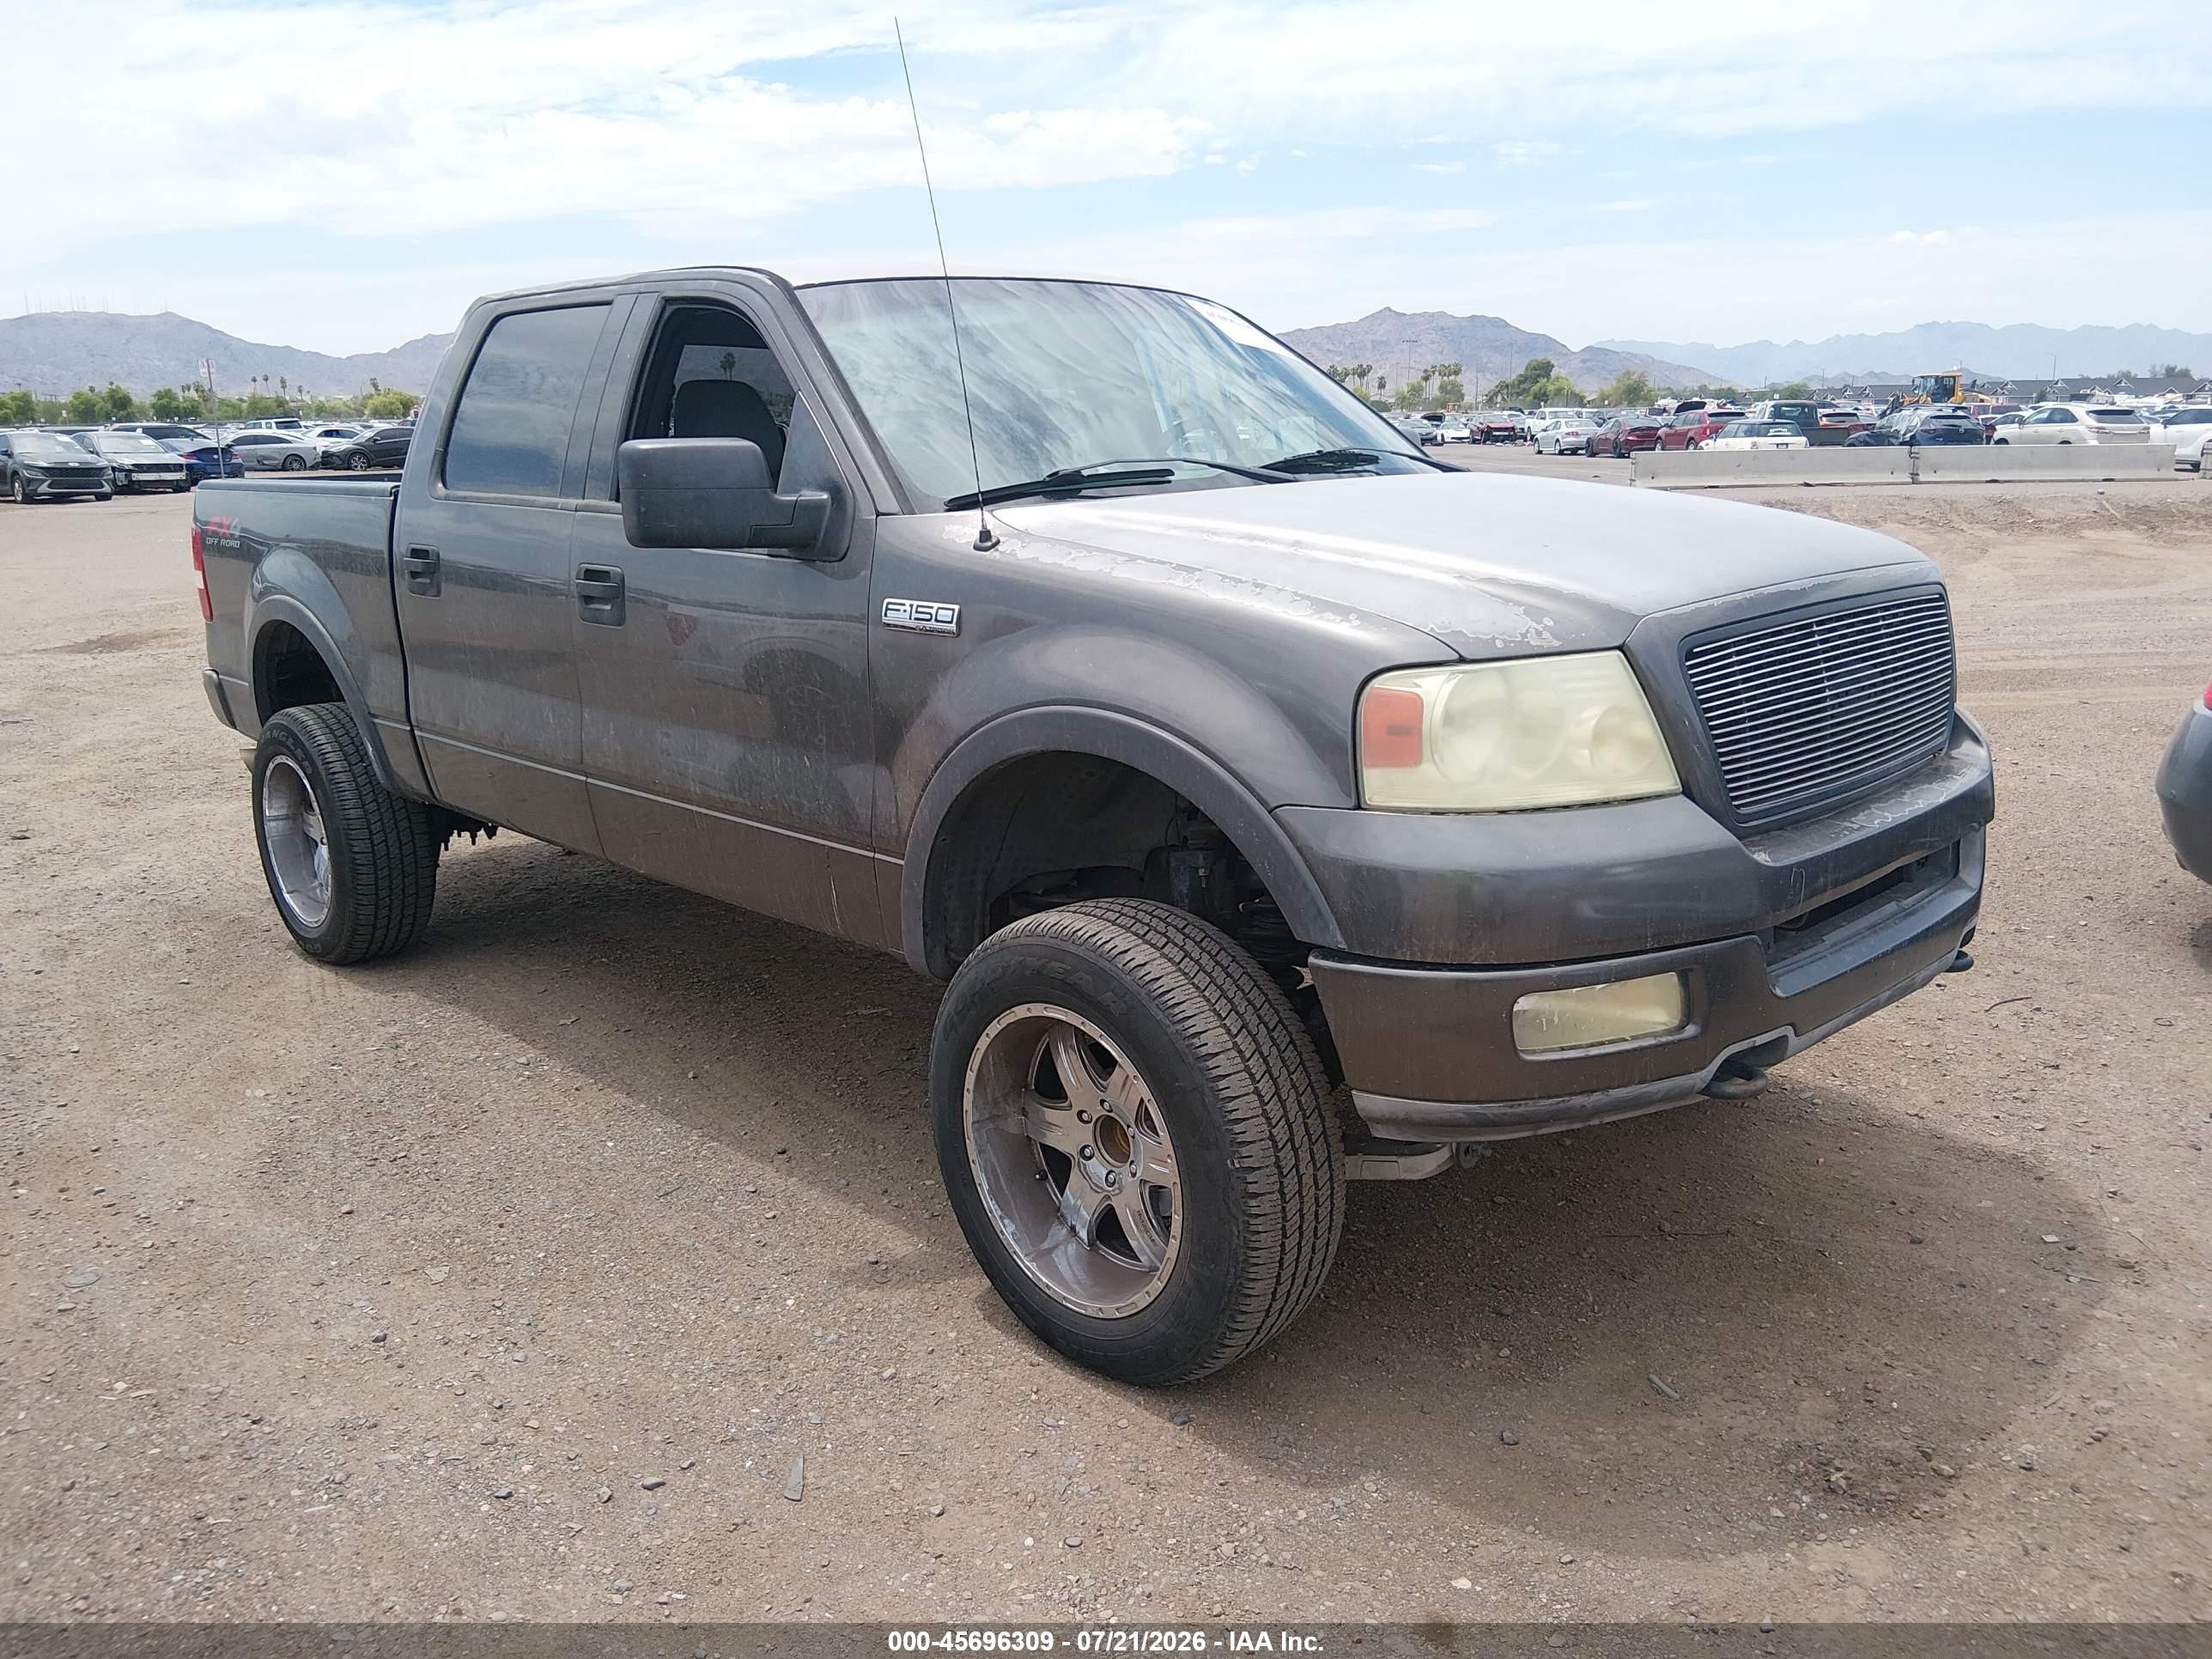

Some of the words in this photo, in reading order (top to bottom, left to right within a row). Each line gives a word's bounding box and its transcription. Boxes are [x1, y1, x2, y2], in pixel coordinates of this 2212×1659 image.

[208, 515, 240, 538] FX4
[206, 537, 219, 545] OFF
[220, 538, 240, 548] ROAD
[884, 602, 956, 624] F-150
